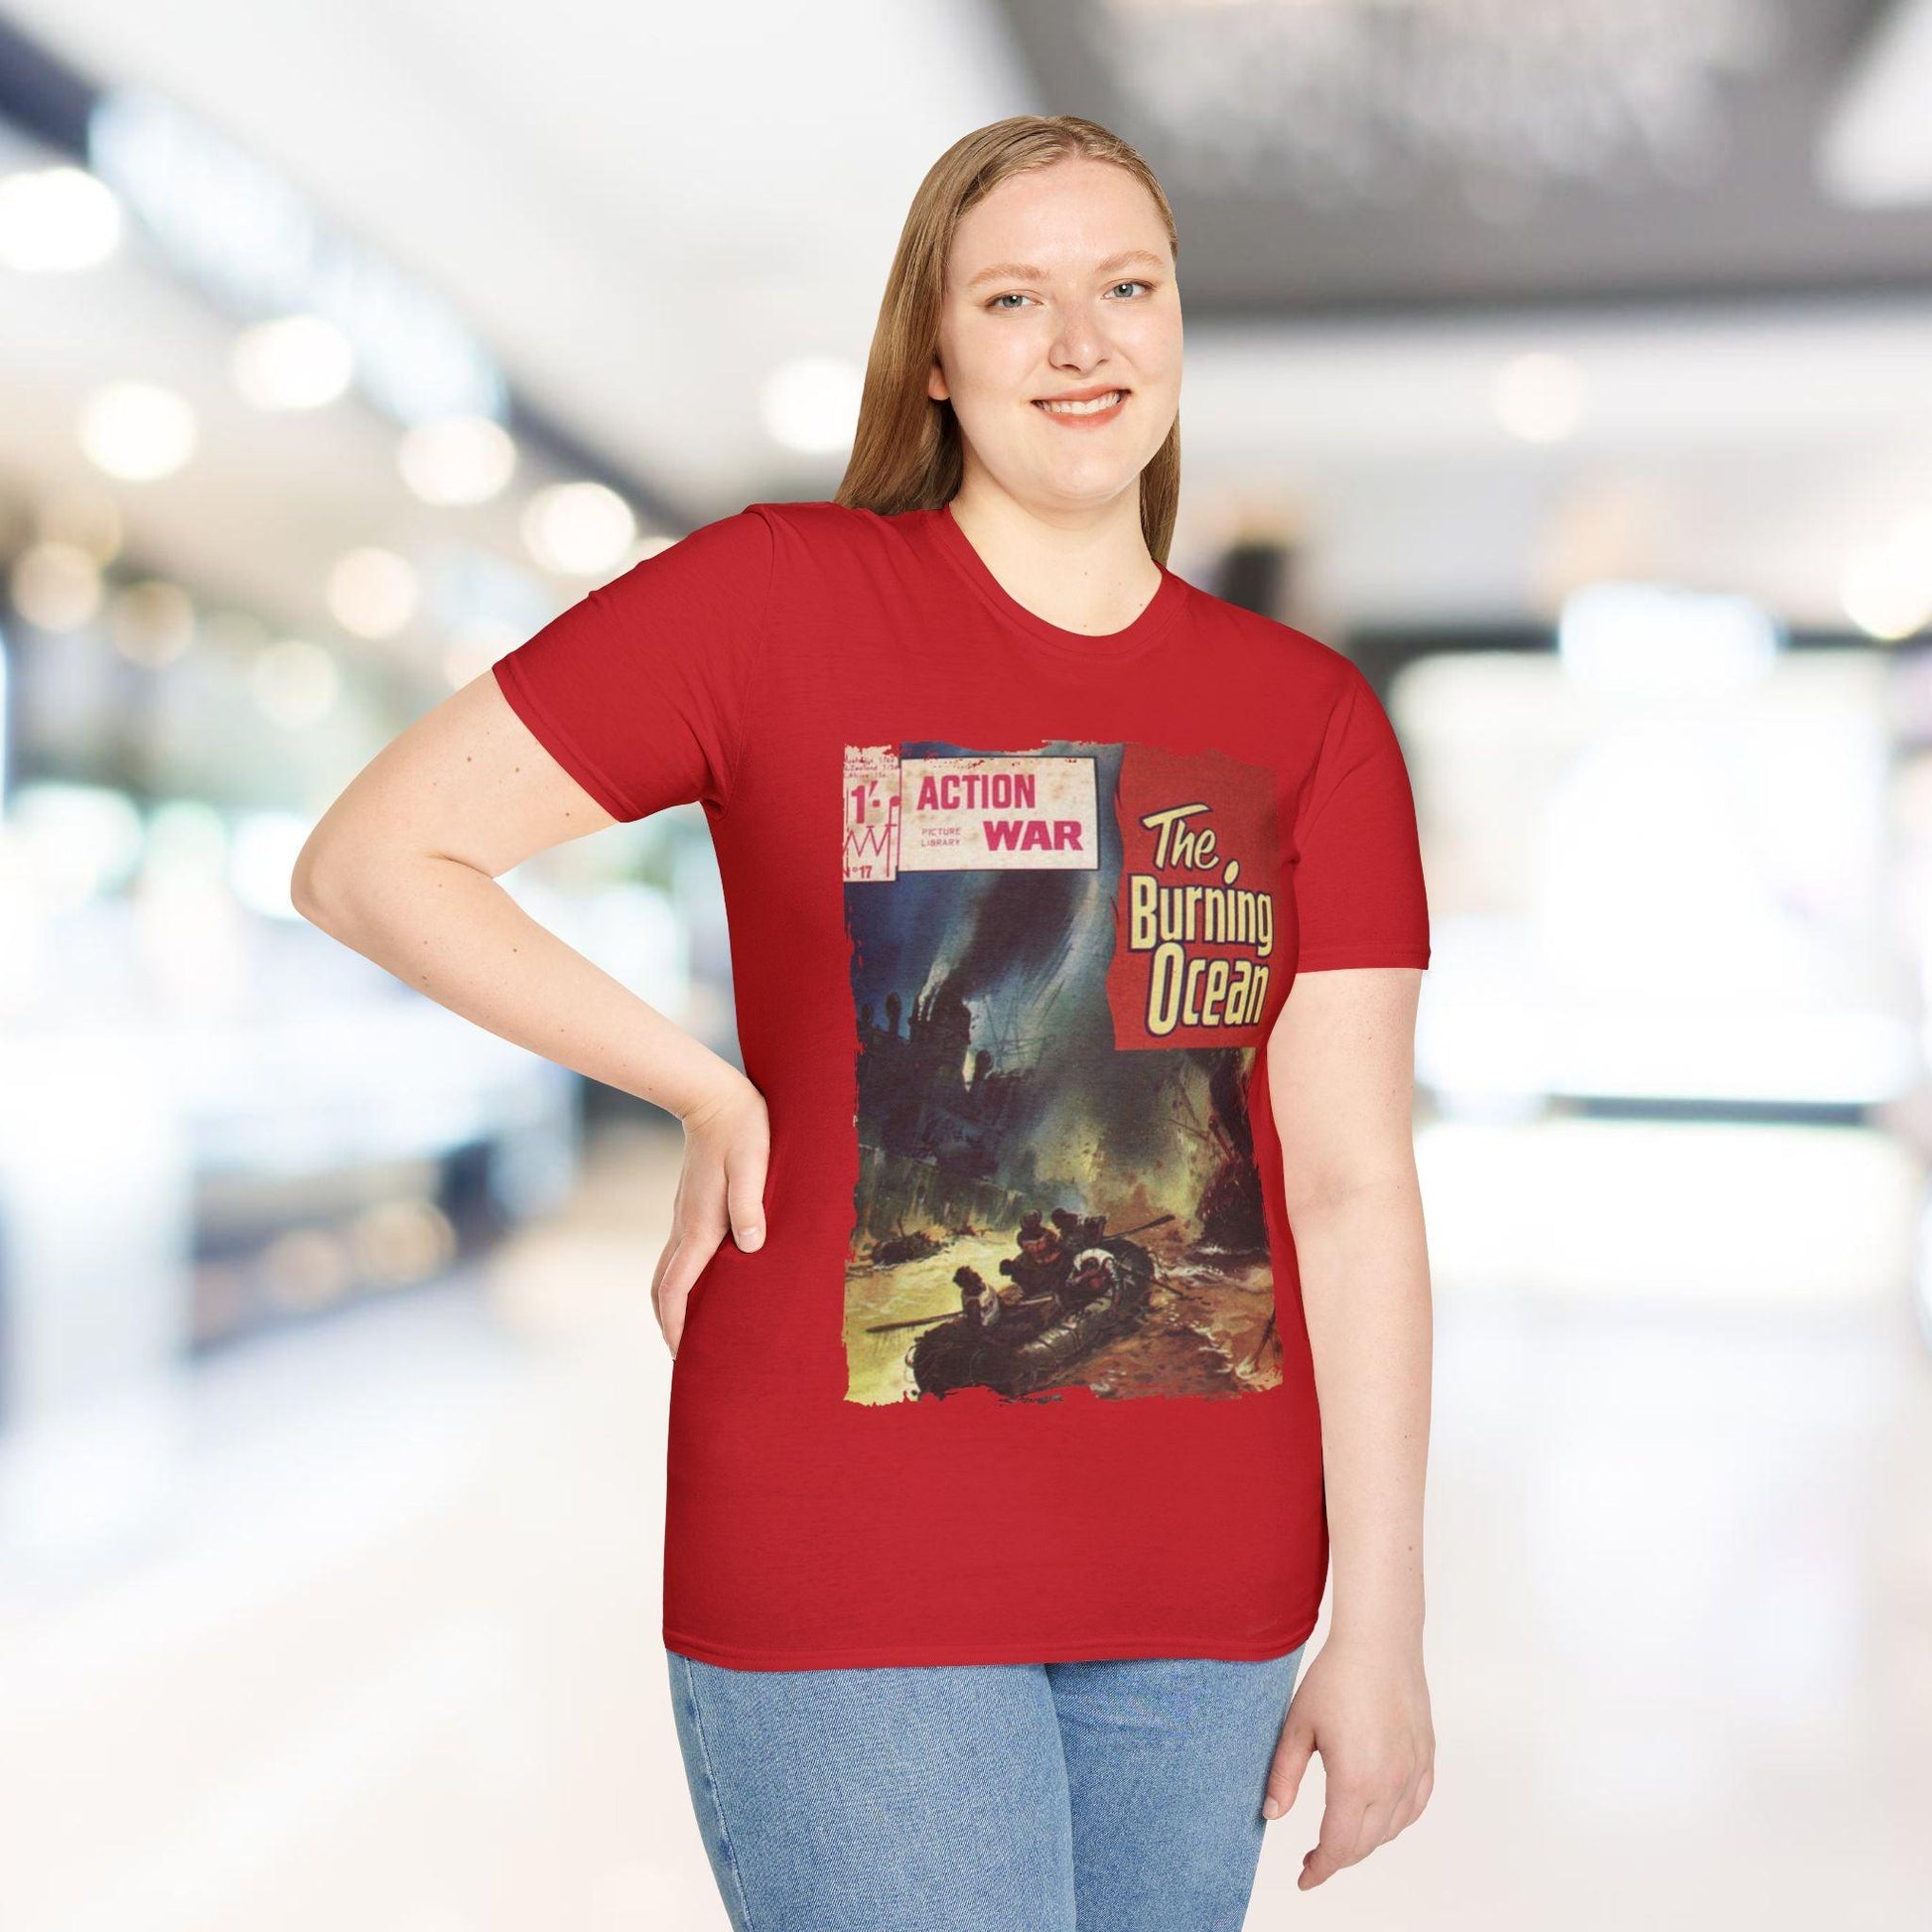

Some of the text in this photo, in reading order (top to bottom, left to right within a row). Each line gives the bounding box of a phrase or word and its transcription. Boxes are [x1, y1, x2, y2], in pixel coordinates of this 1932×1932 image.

[916, 773, 1035, 811] ACTION
[921, 826, 962, 836] PICTURE
[983, 820, 1084, 851] WAR
[1140, 802, 1221, 871] The
[1129, 860, 1275, 958] Burning
[1146, 941, 1270, 1036] Ocean
